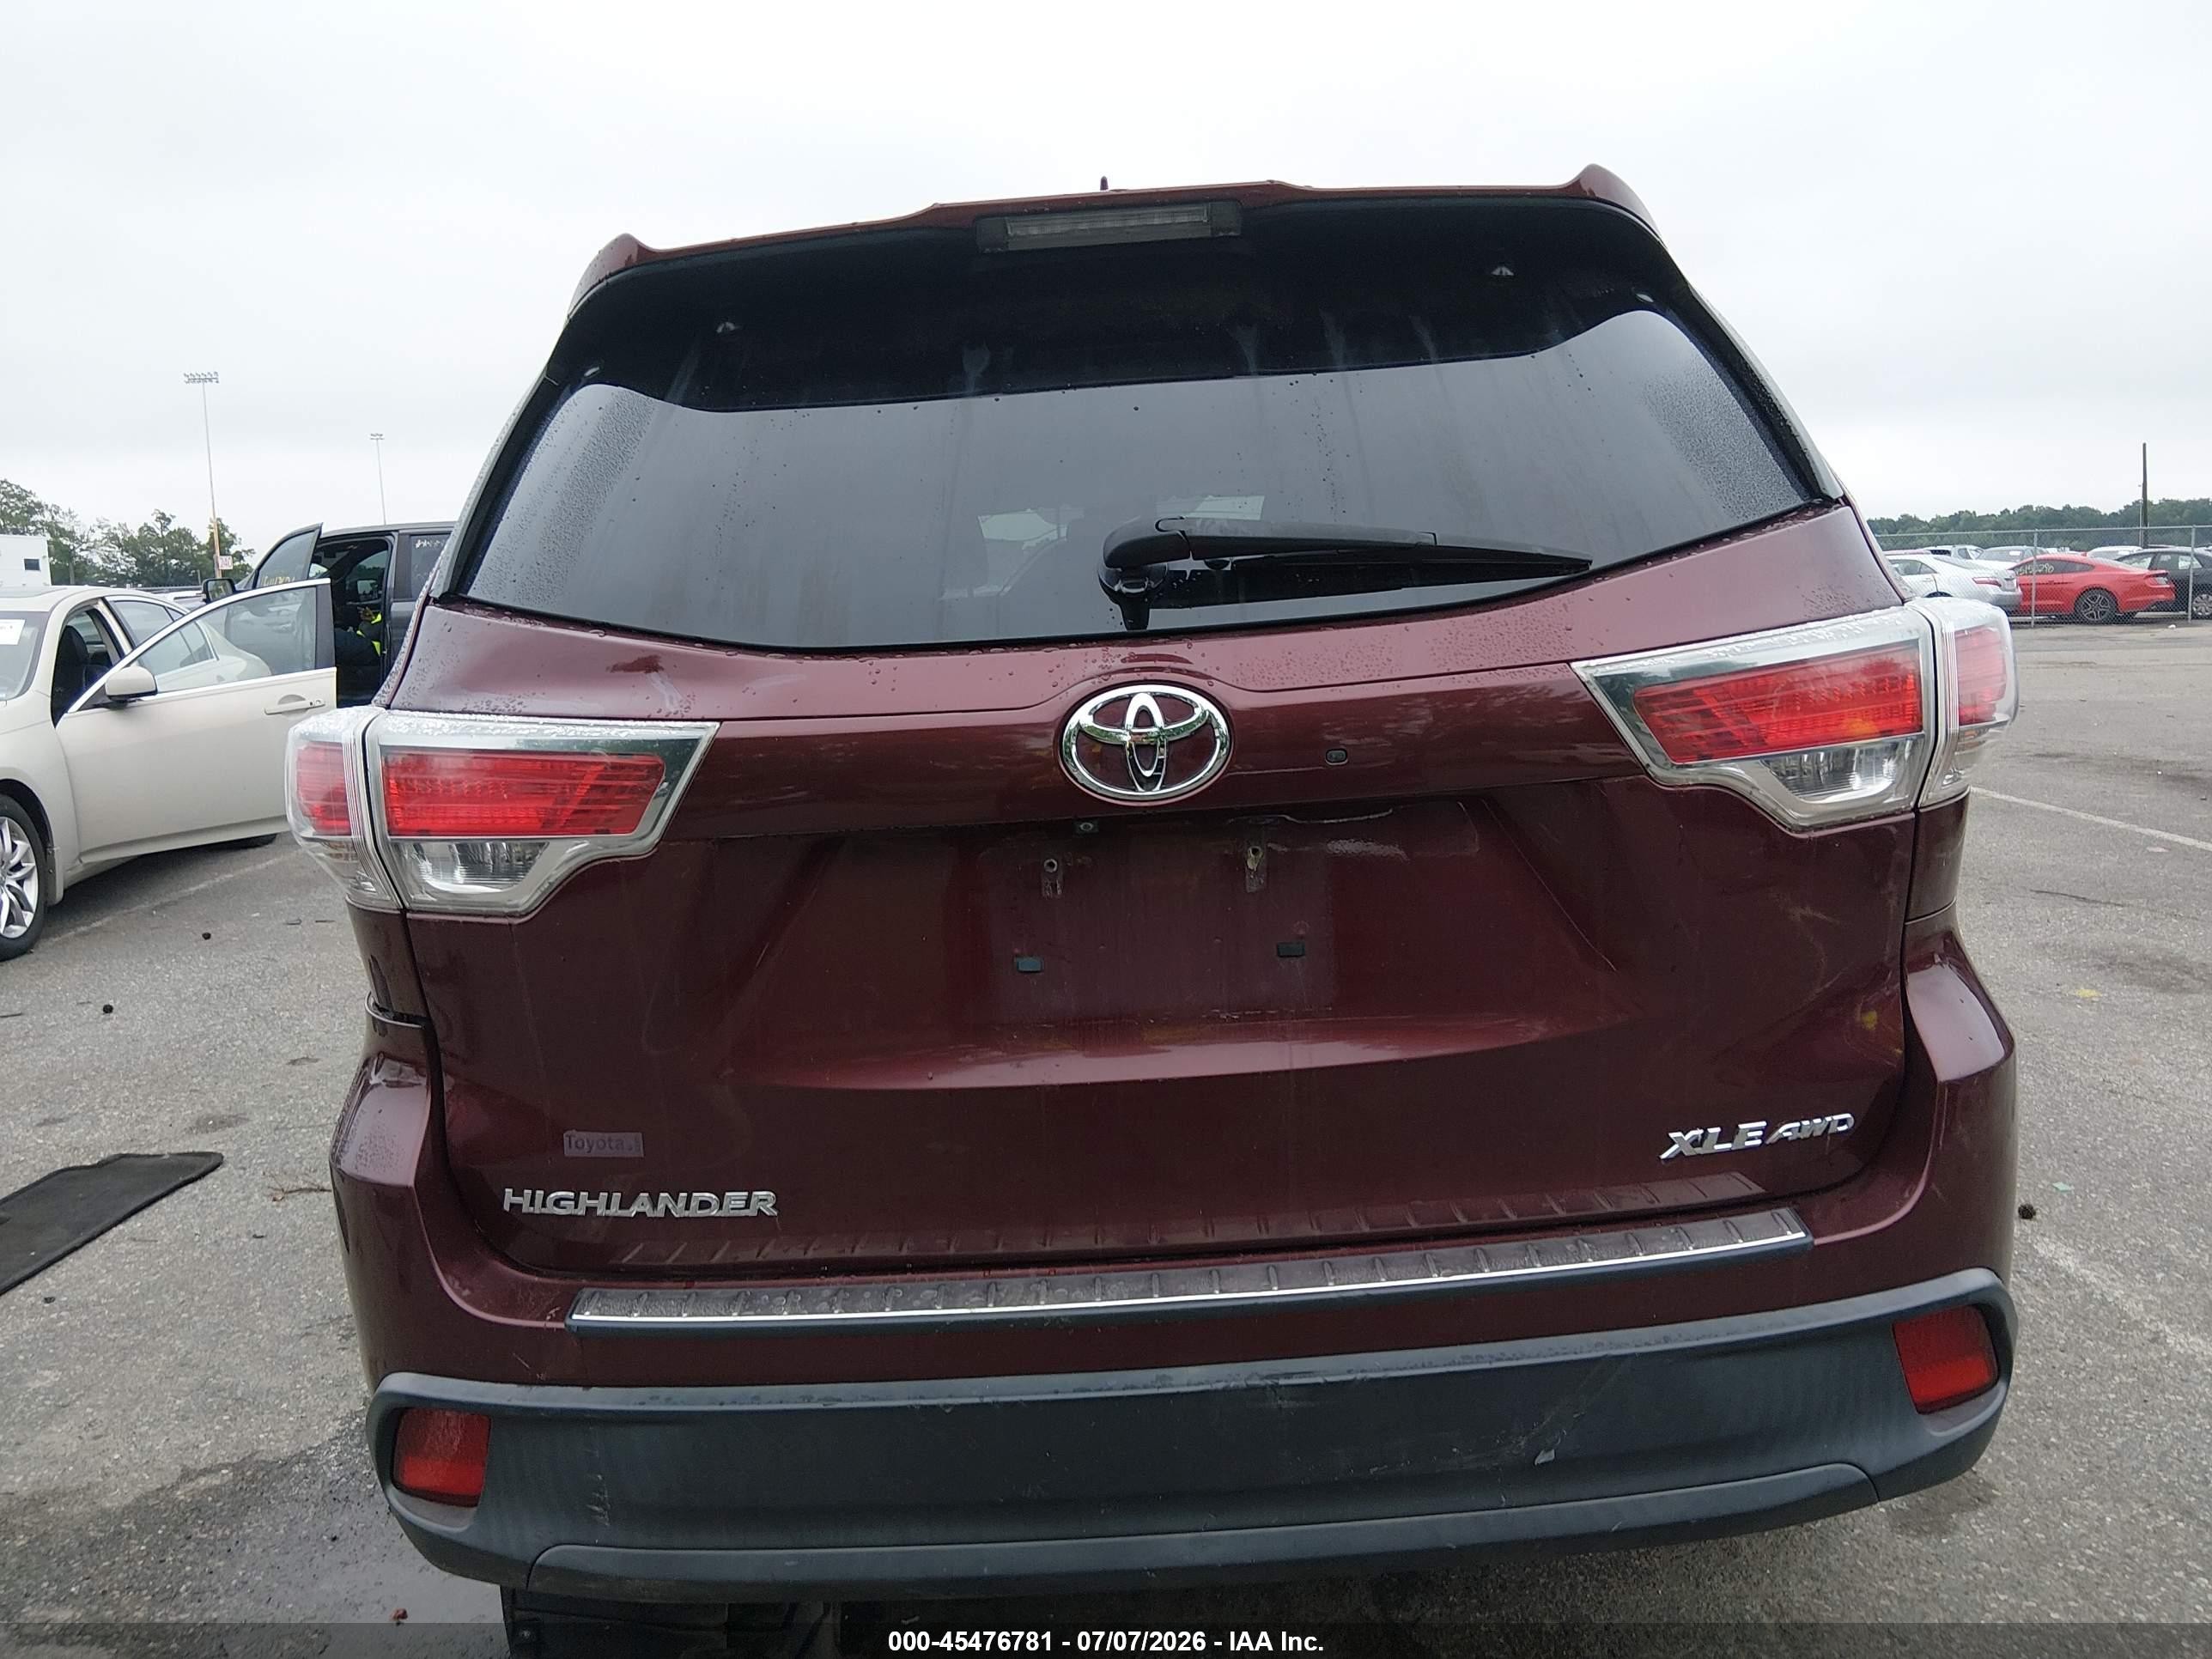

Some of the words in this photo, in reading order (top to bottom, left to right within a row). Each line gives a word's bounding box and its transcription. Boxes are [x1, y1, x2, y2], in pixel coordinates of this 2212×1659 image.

[1659, 1121, 1767, 1159] XLE
[1765, 1113, 1855, 1145] AWD
[503, 1188, 778, 1218] HIGHLANDER
